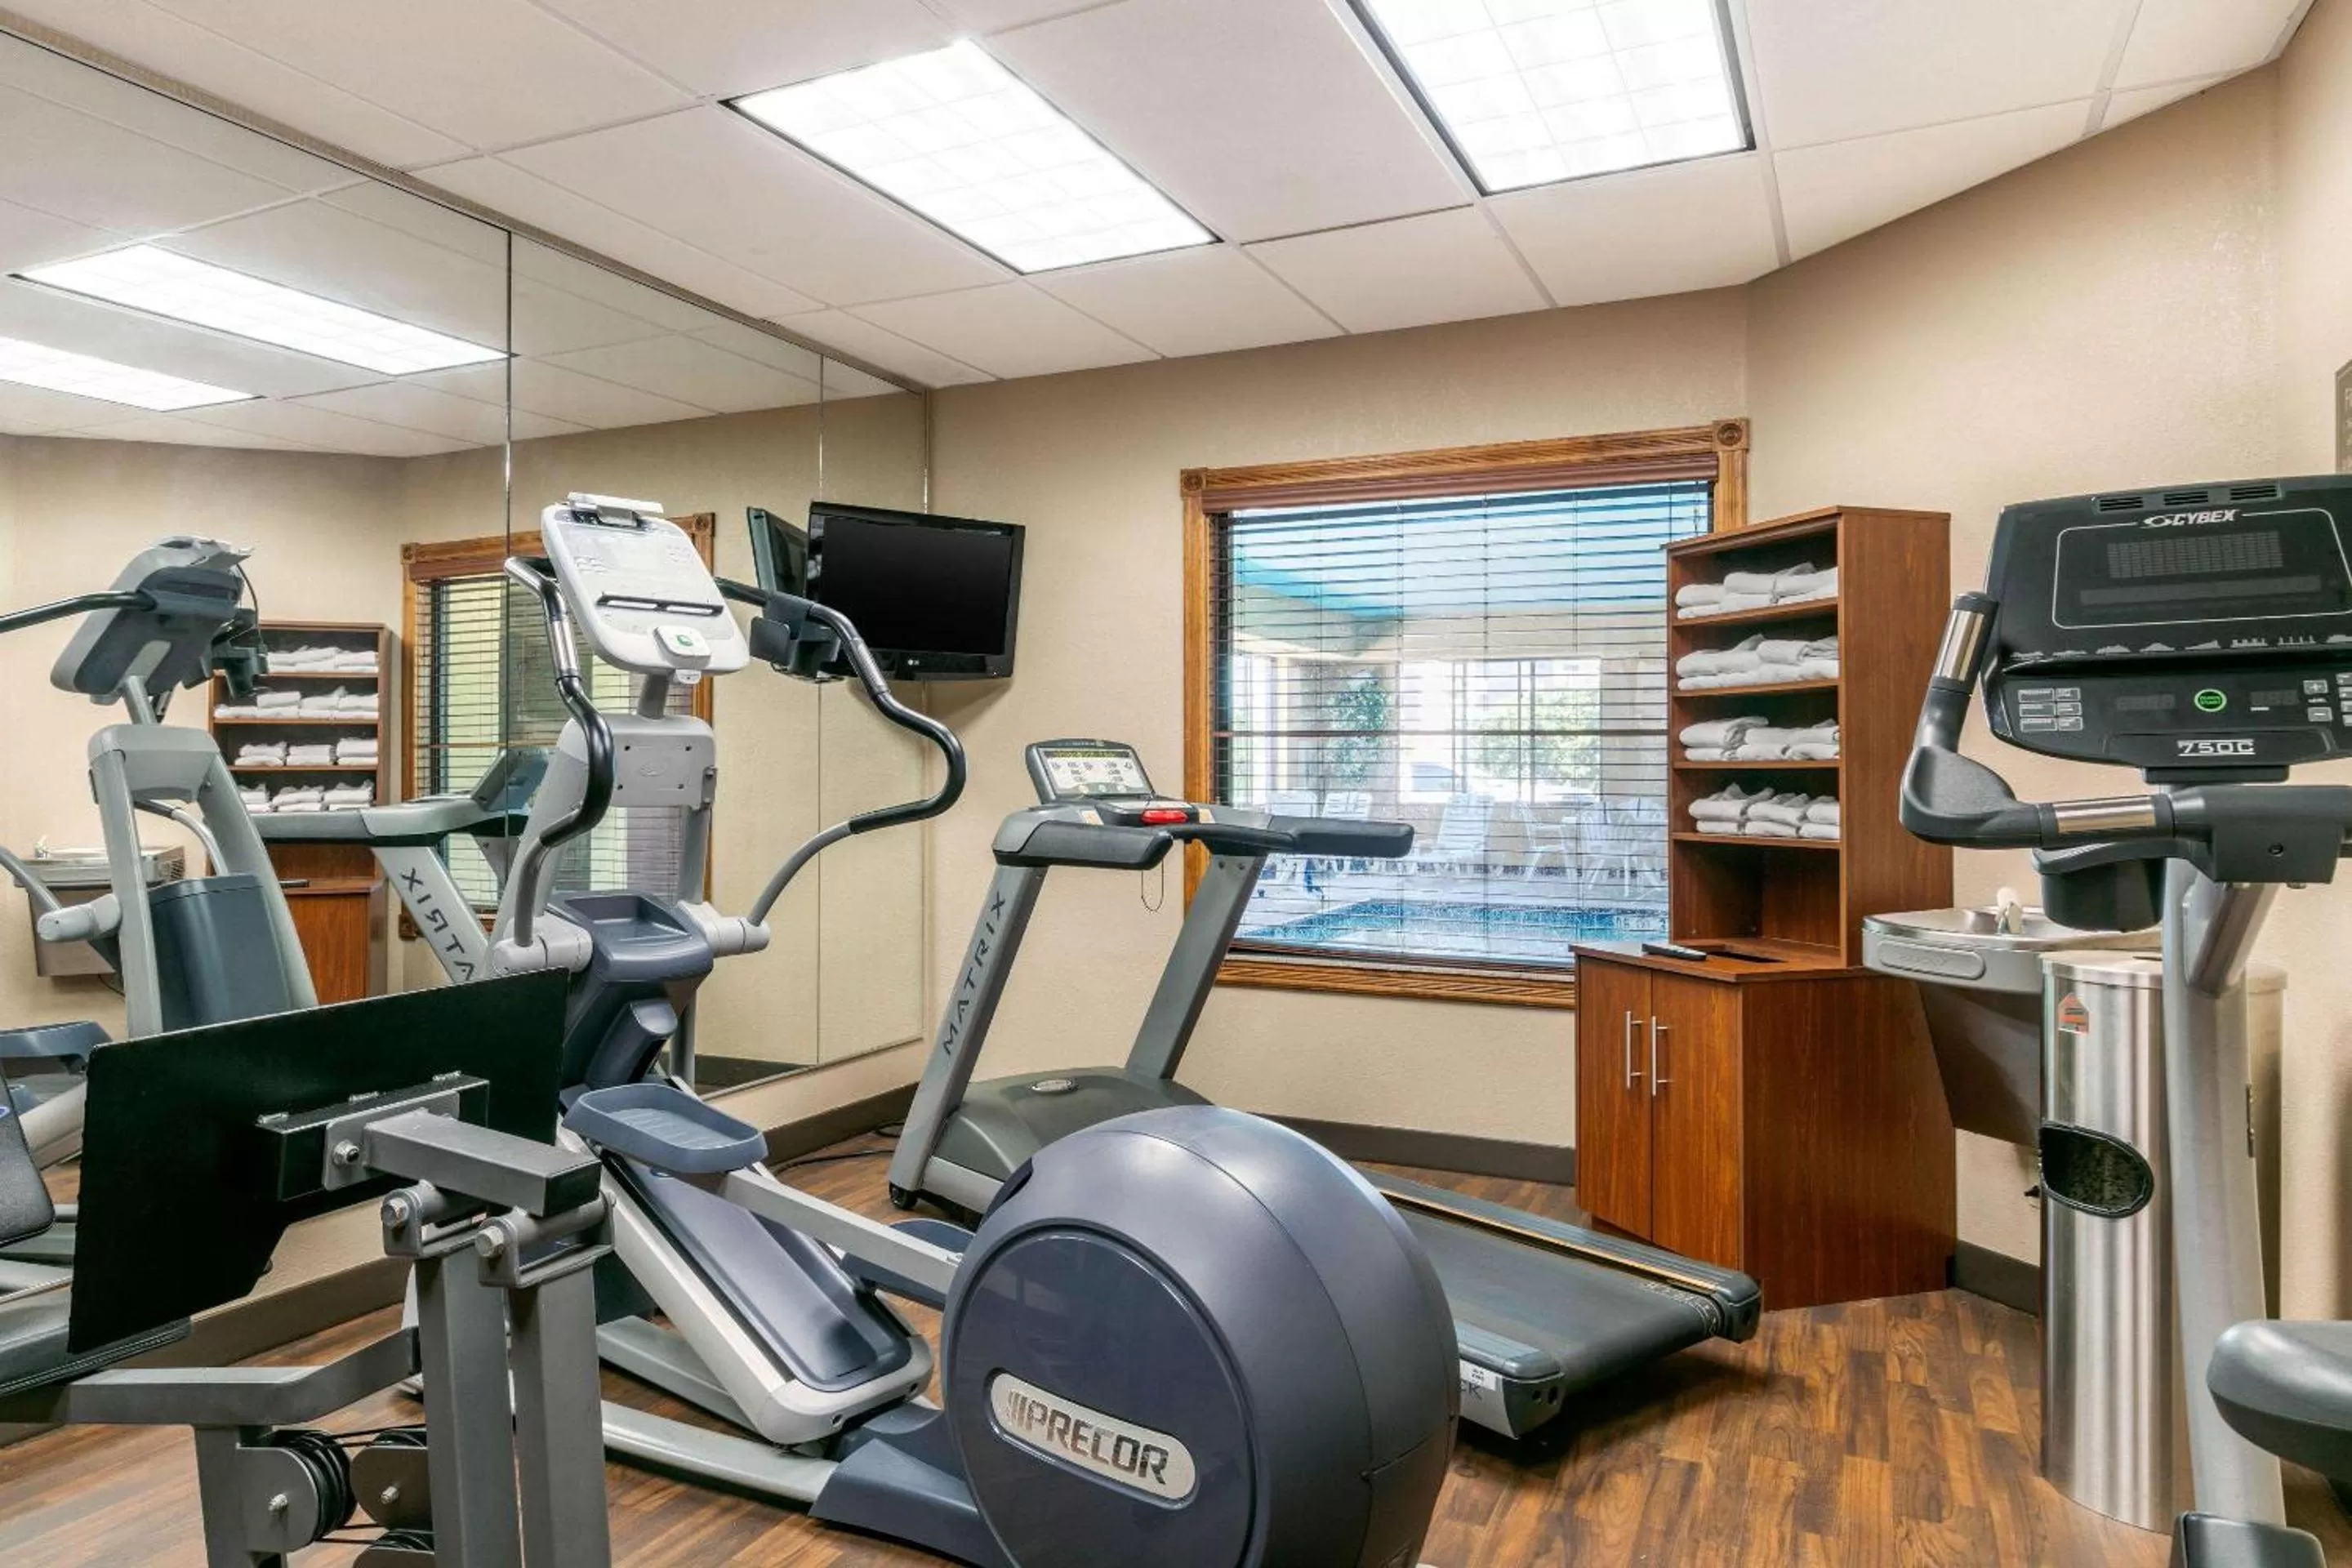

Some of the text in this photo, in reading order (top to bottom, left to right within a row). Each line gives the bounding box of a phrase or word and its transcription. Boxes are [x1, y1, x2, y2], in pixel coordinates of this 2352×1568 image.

[2172, 509, 2239, 526] CYBEX
[2177, 739, 2255, 755] 750C
[942, 891, 1005, 1056] MATRIX
[1026, 1399, 1169, 1486] PRECOR
